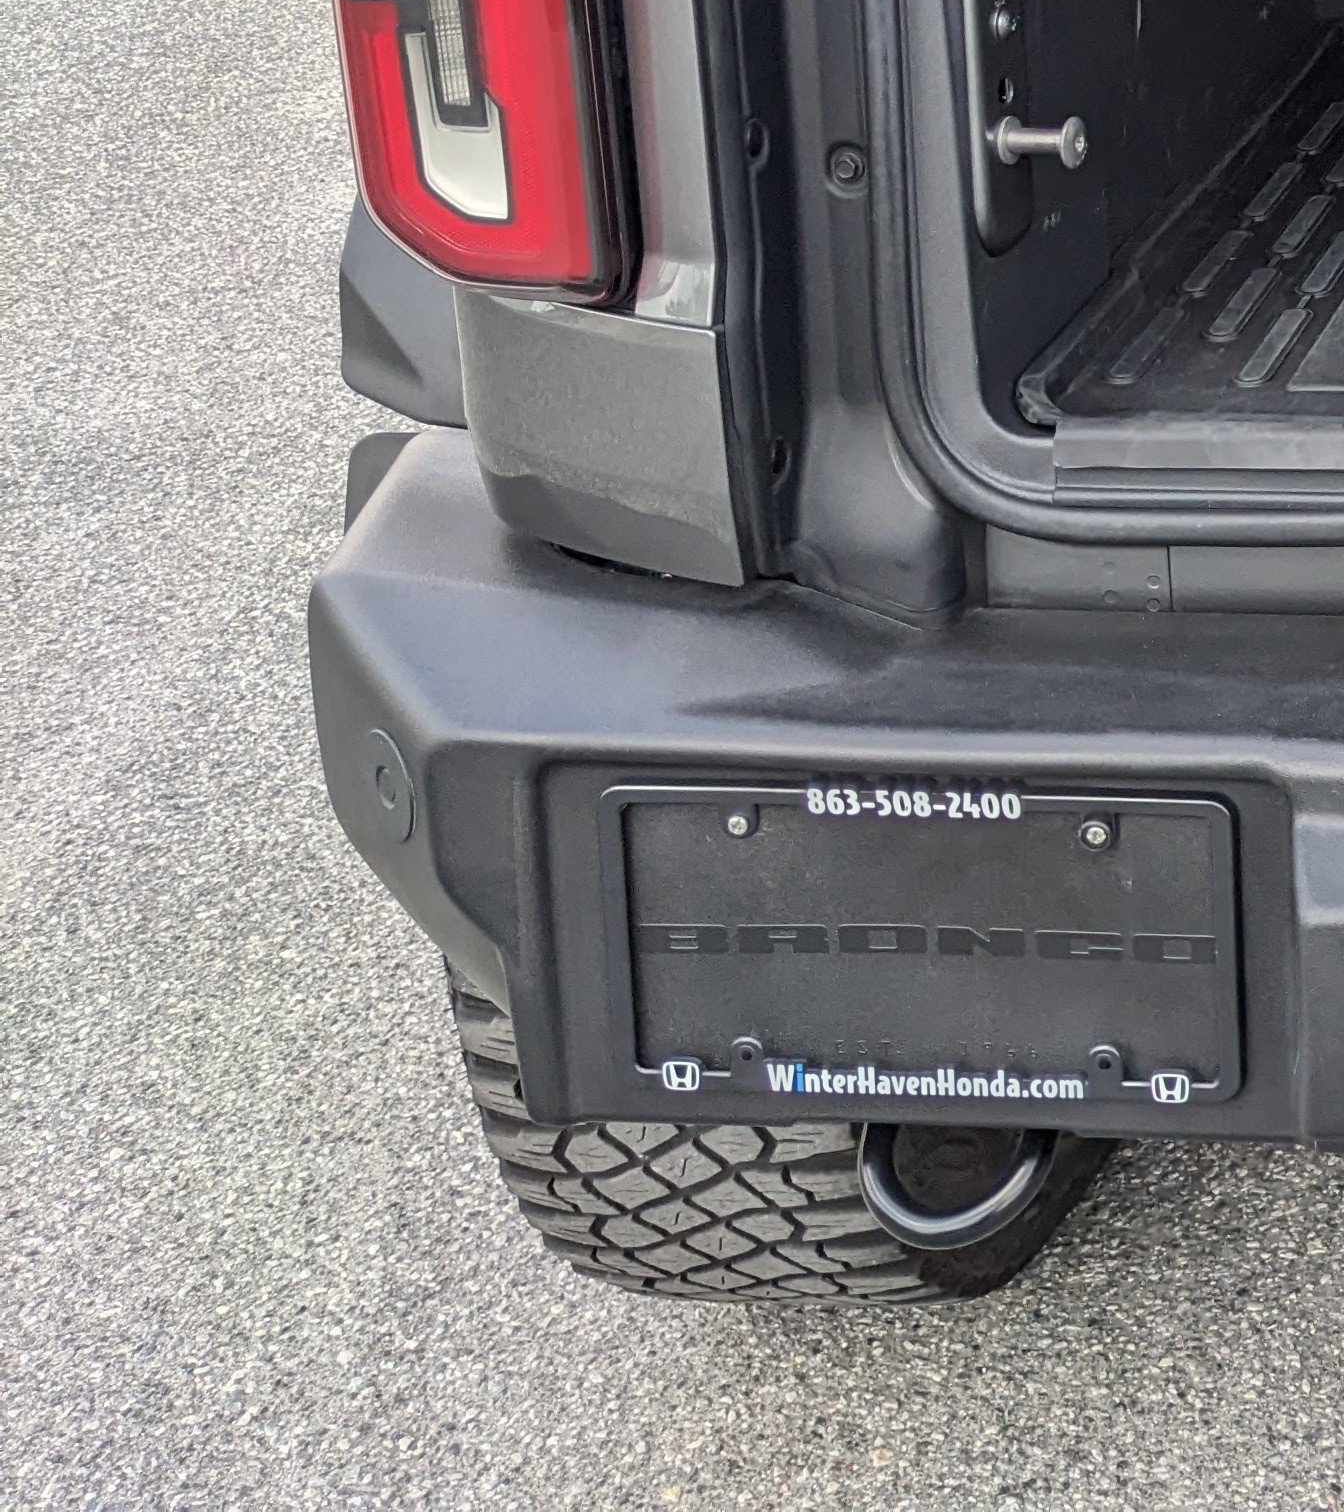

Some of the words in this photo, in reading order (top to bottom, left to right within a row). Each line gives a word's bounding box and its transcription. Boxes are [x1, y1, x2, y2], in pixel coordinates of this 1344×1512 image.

[806, 788, 1022, 819] 863-508-2400
[638, 923, 1217, 964] BRONCO
[767, 1062, 1084, 1099] WinterHavenHonda.com
